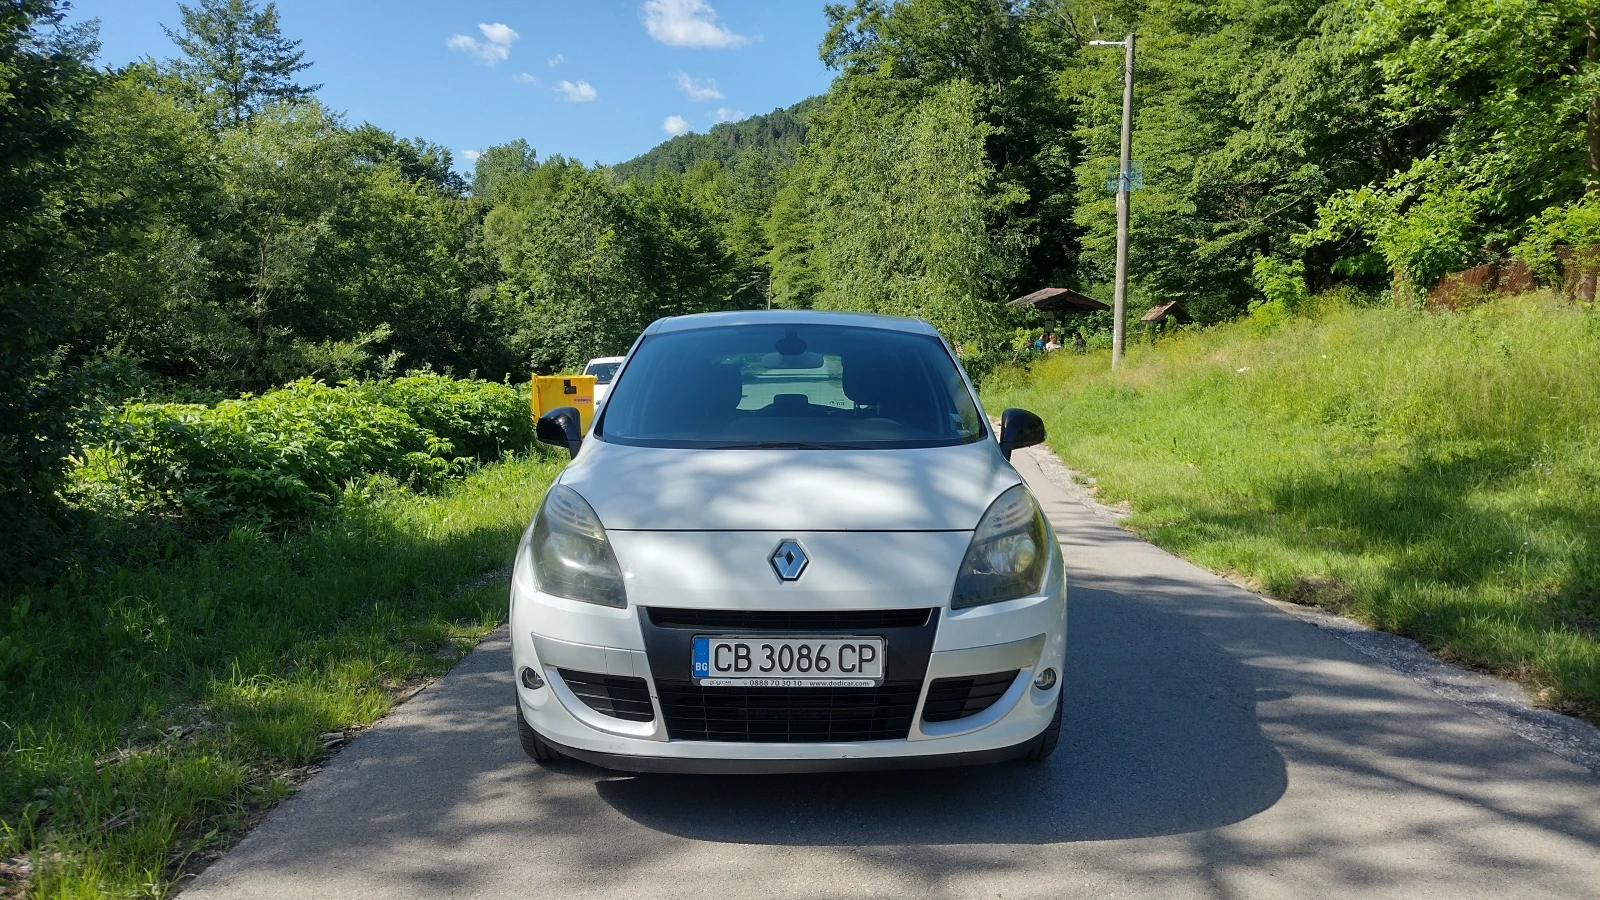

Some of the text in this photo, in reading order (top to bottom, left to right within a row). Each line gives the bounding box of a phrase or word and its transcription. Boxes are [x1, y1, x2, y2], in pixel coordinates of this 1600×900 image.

[713, 643, 876, 673] CB 3086 CP
[695, 662, 708, 671] BG
[749, 679, 769, 687] 0888
[770, 679, 779, 687] 70
[782, 679, 791, 687] 30
[793, 679, 802, 687] 10
[809, 679, 869, 687] www.dodicar.com
